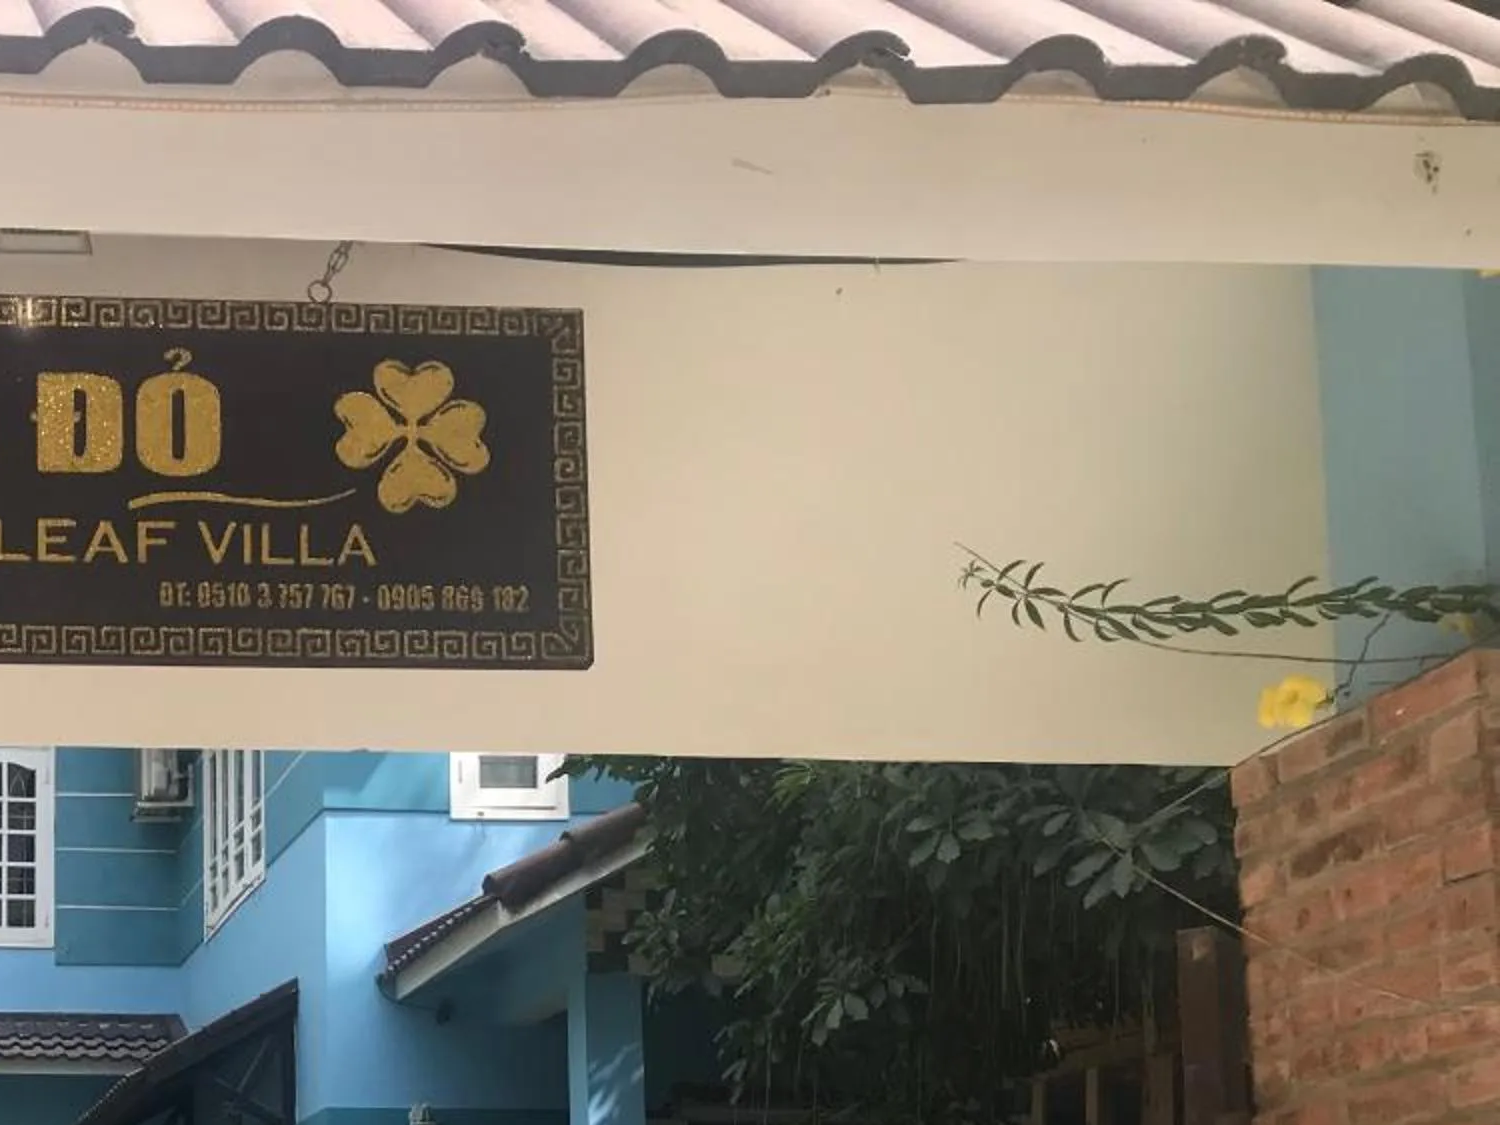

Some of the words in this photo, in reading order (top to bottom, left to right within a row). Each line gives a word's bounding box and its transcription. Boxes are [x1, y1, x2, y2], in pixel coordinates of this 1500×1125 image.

[30, 346, 222, 477] ĐỎ
[198, 521, 377, 567] VILLA
[377, 584, 435, 611] 0905
